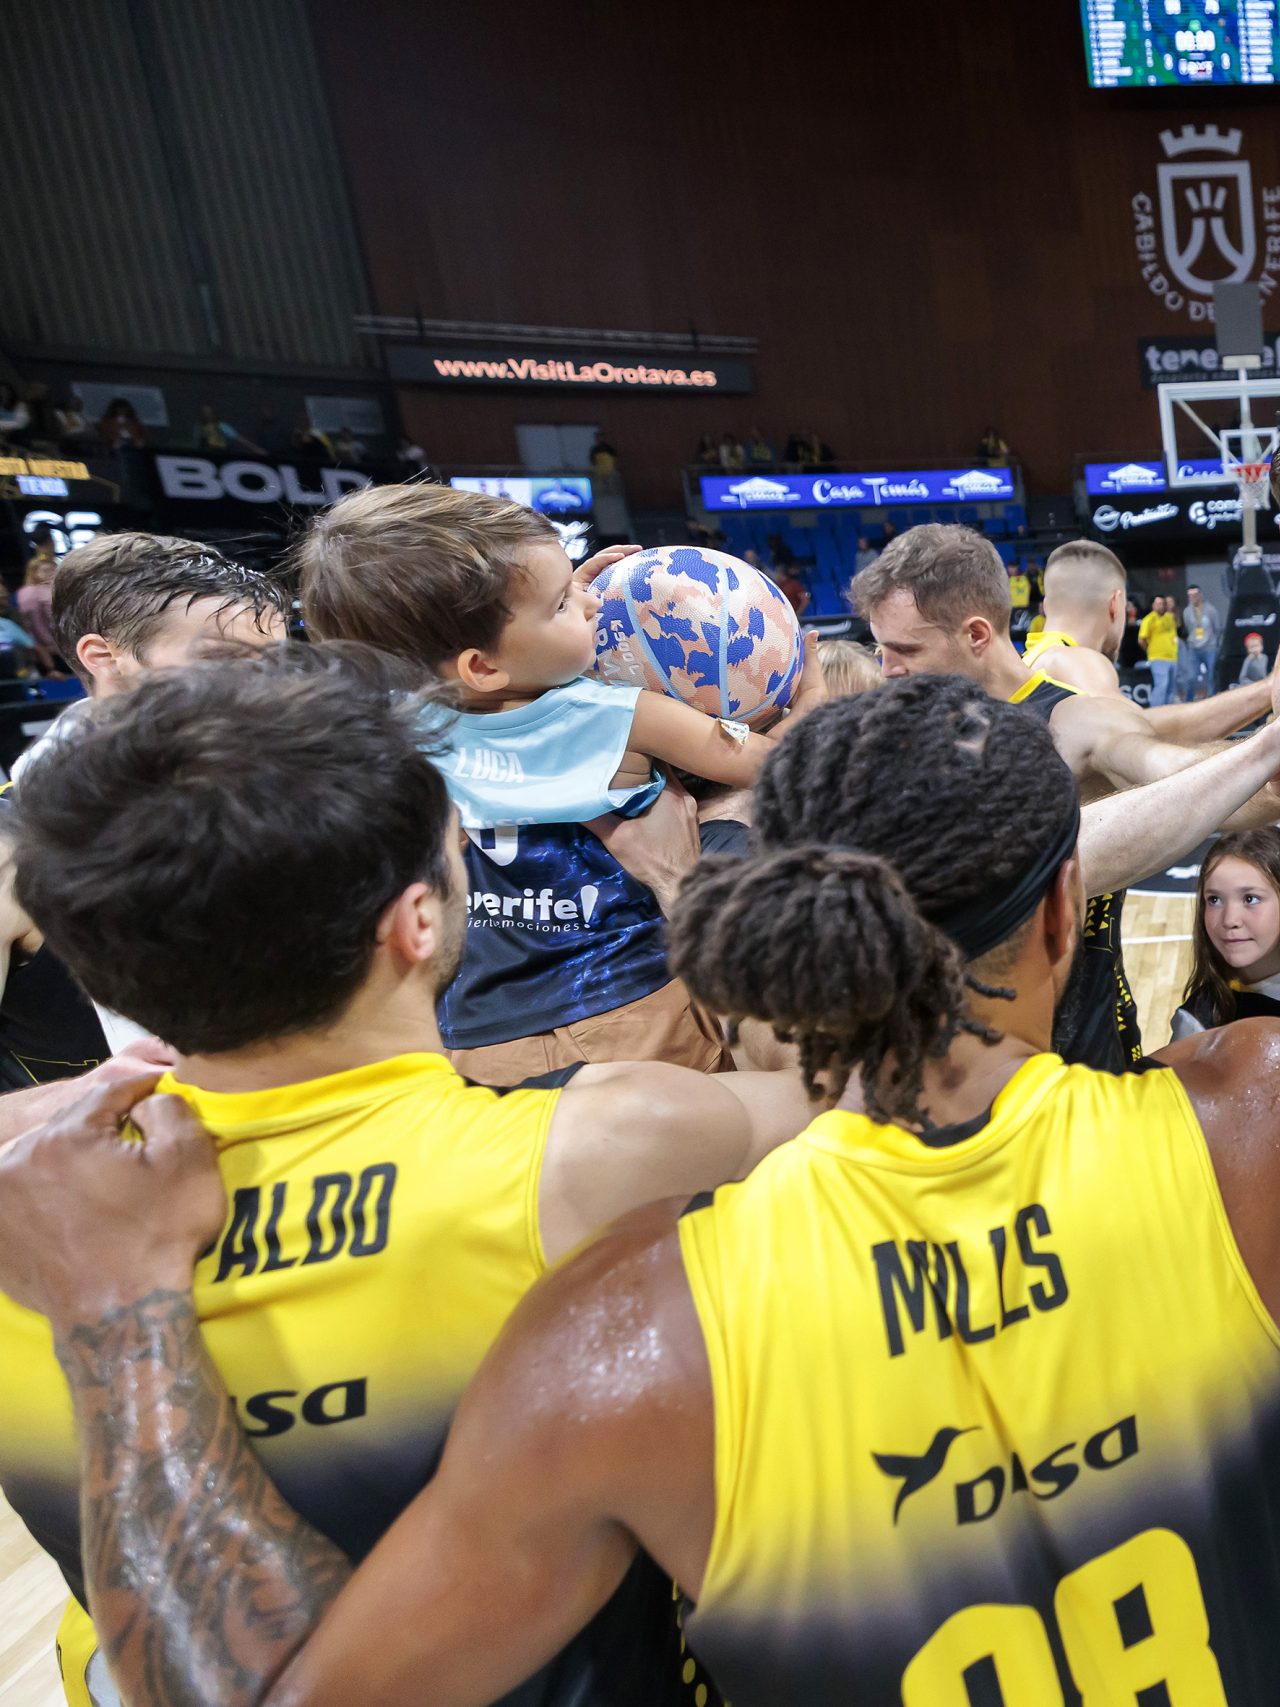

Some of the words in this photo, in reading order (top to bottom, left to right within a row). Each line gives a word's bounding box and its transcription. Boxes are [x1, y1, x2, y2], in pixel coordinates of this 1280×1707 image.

[1131, 191, 1185, 311] CABILDO
[433, 358, 718, 387] www.VisitLaOrotava.es
[812, 479, 866, 504] Casa
[861, 477, 929, 506] Tomás
[452, 747, 525, 783] LUCA
[195, 1161, 398, 1284] ALDO
